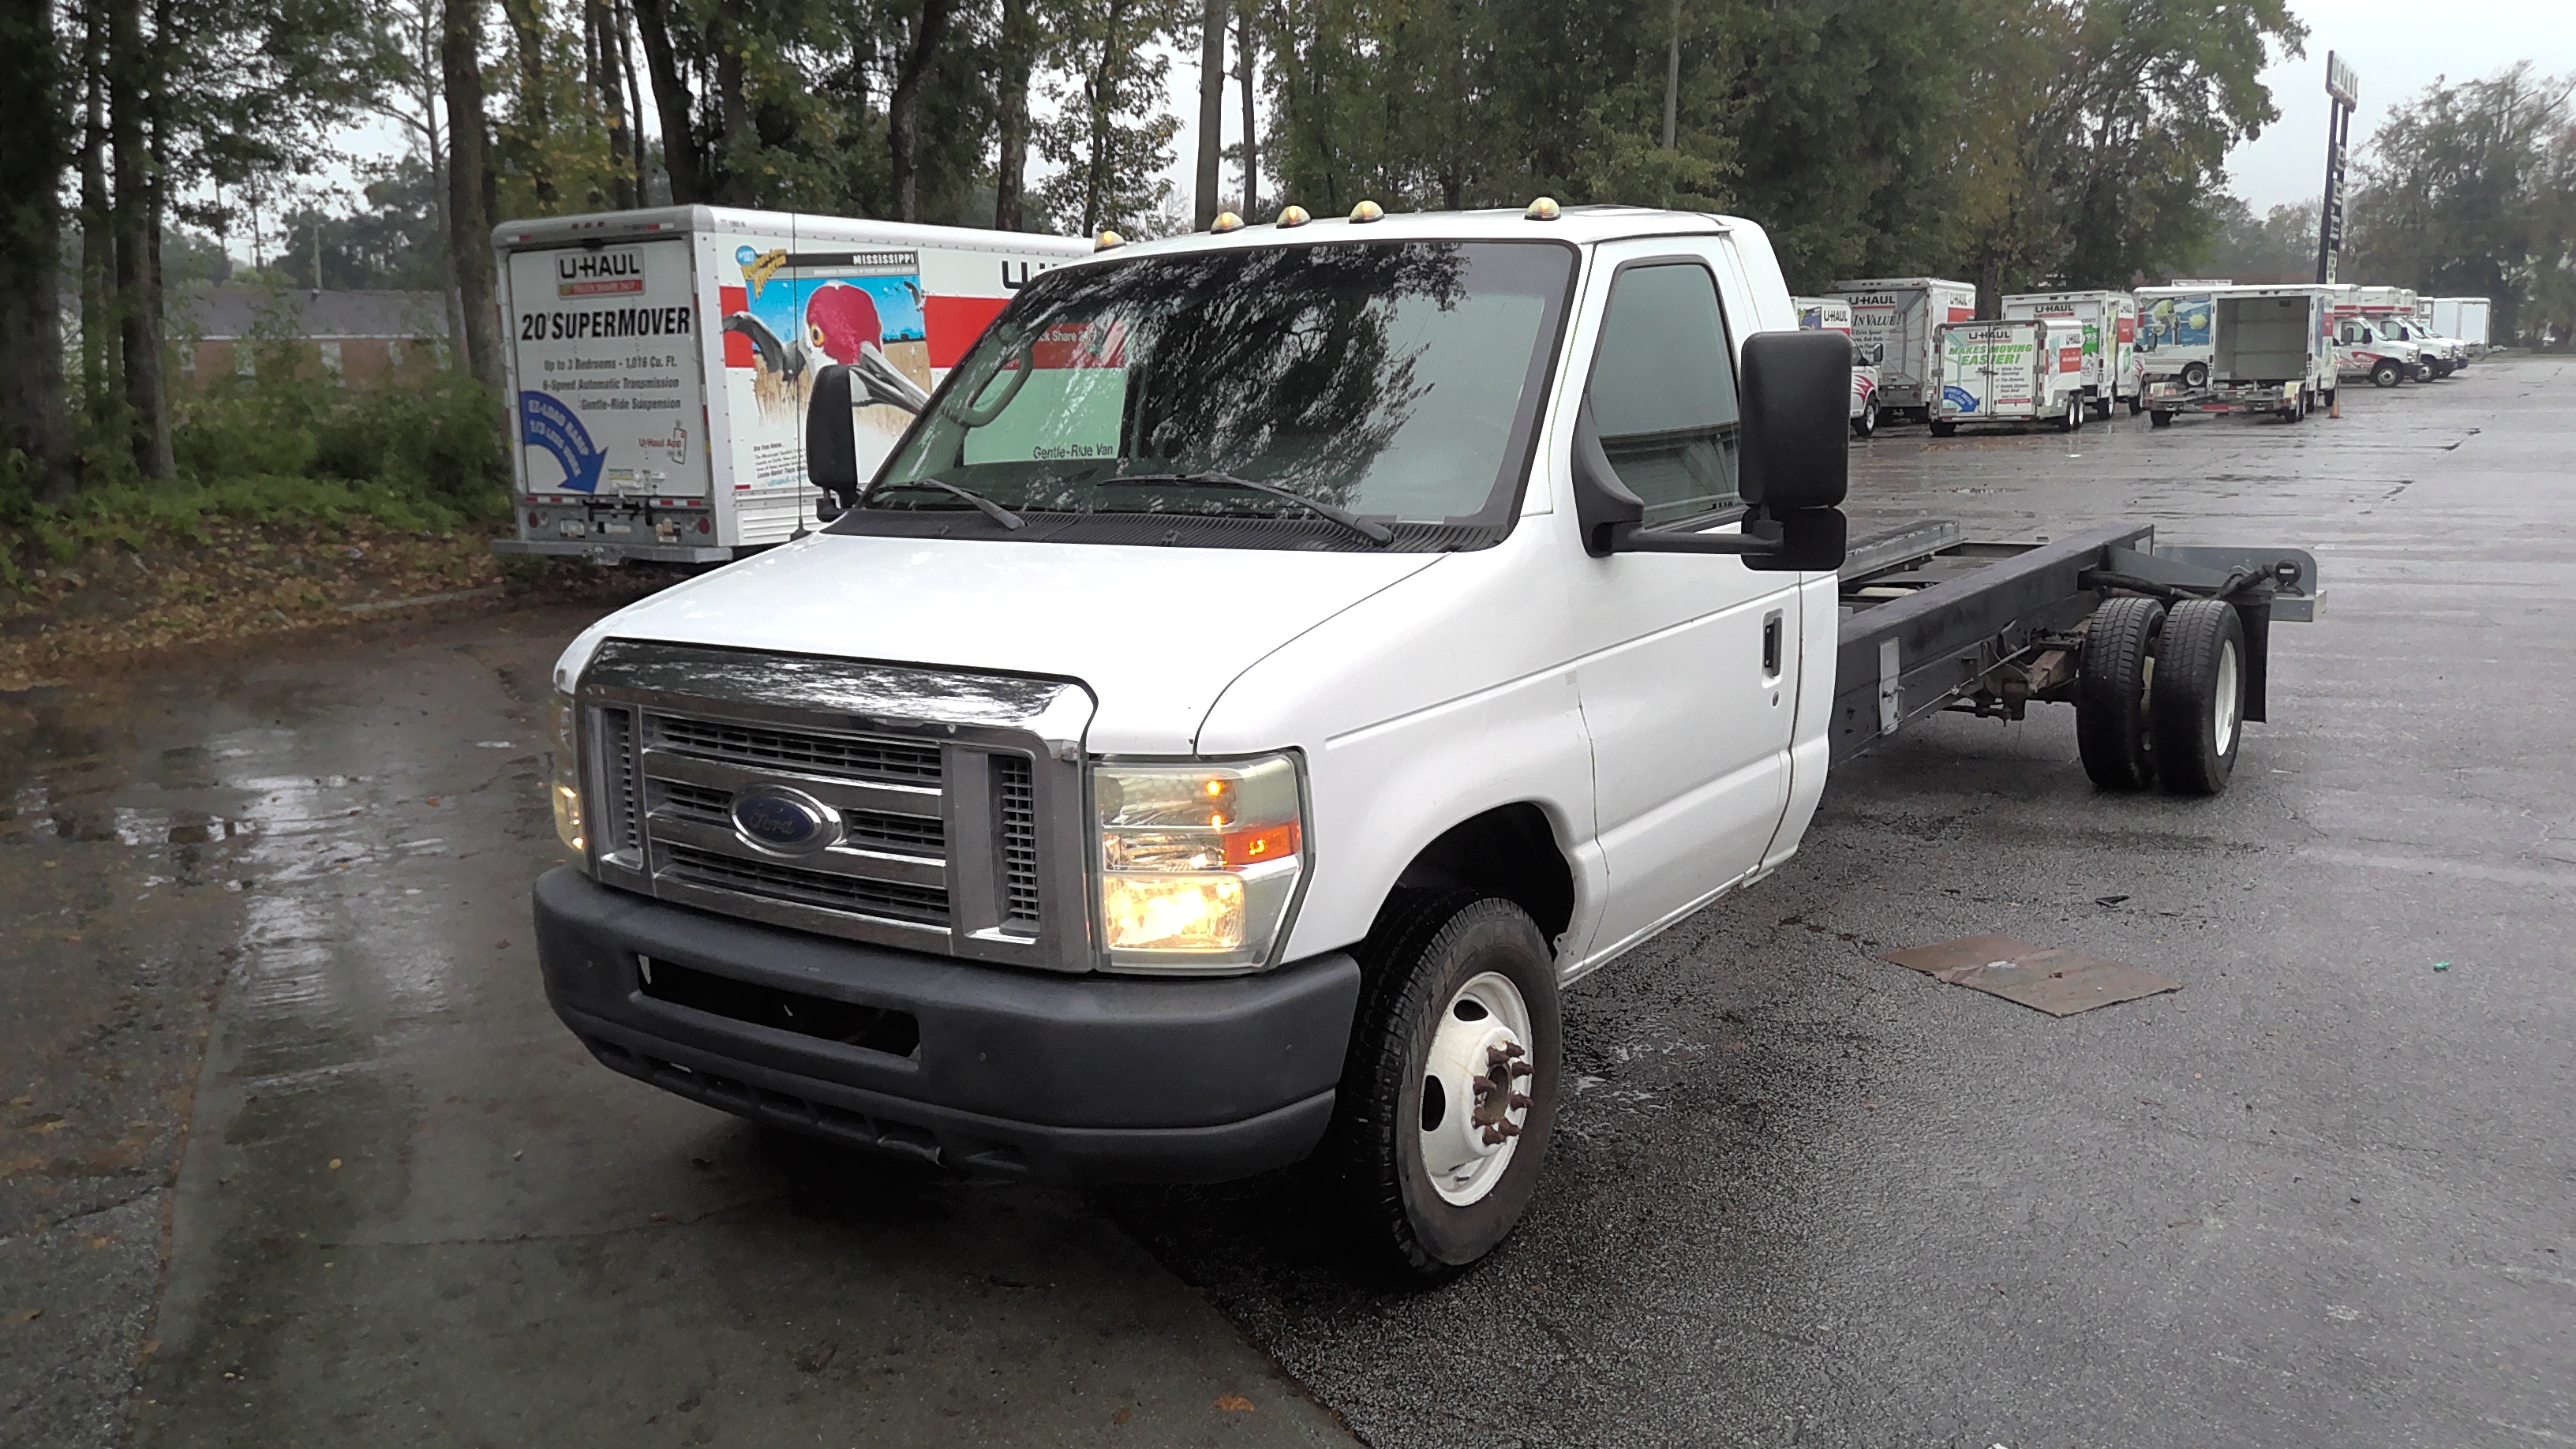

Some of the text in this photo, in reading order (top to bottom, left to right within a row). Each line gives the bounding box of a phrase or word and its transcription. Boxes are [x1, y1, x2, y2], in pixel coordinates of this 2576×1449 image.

[852, 253, 915, 265] MISSISSIPPI
[560, 253, 640, 279] U-HAUL
[1848, 295, 1896, 305] U-HAUL
[1823, 309, 1848, 322] U-HAUL
[552, 306, 691, 339] SUPERMOVER
[1052, 331, 1076, 342] Share
[1968, 331, 2010, 340] U-HAUL
[1949, 344, 2033, 354] MAKES MOVING
[544, 359, 555, 372] Up
[556, 359, 565, 371] to
[567, 358, 573, 370] 3
[575, 358, 616, 370] Bedrooms
[650, 356, 664, 368] Cu.
[665, 355, 677, 367] Ft.
[577, 378, 620, 391] Automatic
[623, 376, 680, 390] Transmission
[631, 397, 681, 410] Suspension
[666, 437, 681, 448] App
[1033, 443, 1114, 459] Gentle-Ride Van
[748, 811, 796, 835] Ford
